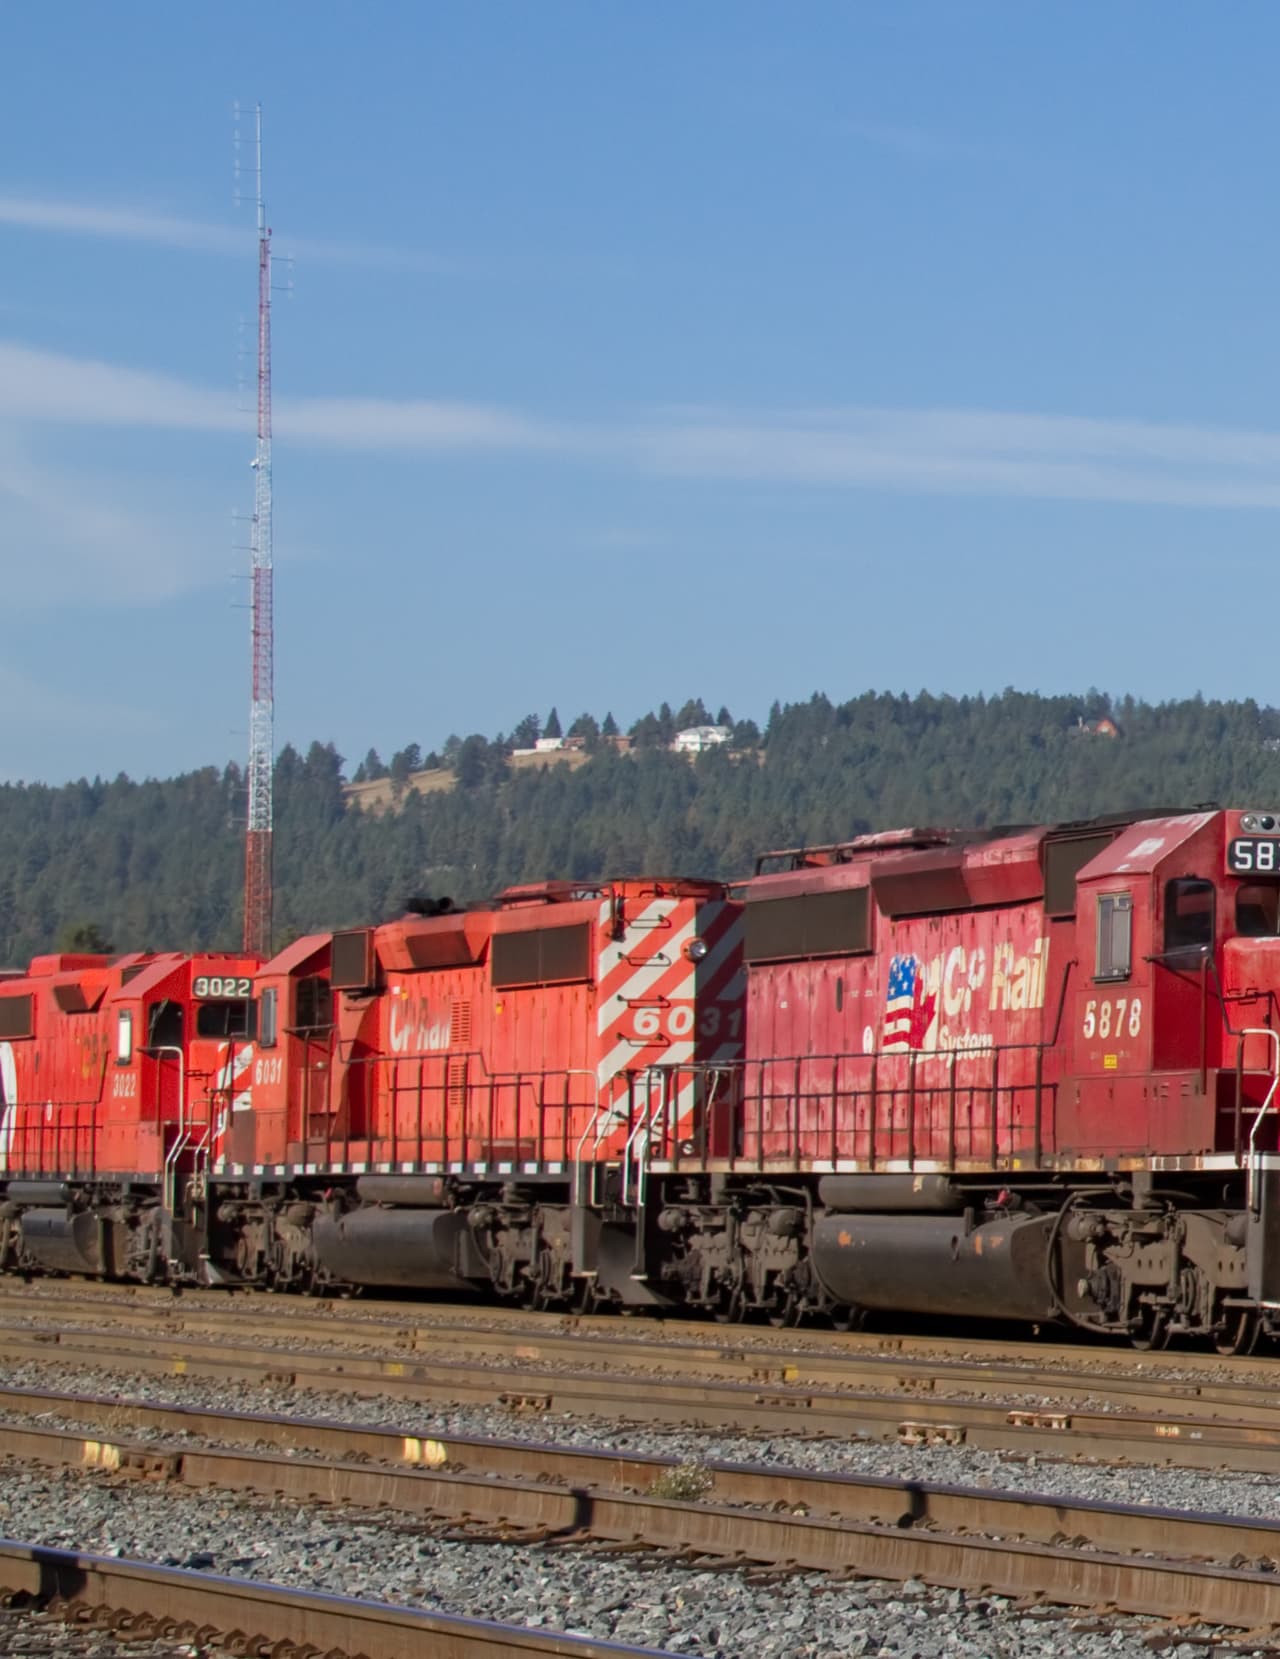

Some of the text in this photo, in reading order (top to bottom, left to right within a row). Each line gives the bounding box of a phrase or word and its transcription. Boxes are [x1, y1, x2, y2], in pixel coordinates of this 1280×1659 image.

[195, 977, 250, 998] 3022
[989, 937, 1051, 1012] Rail
[632, 1005, 743, 1037] 6031
[1083, 998, 1142, 1039] 5878
[939, 1025, 993, 1069] System
[112, 1073, 137, 1097] 3022
[255, 1058, 283, 1084] 6031
